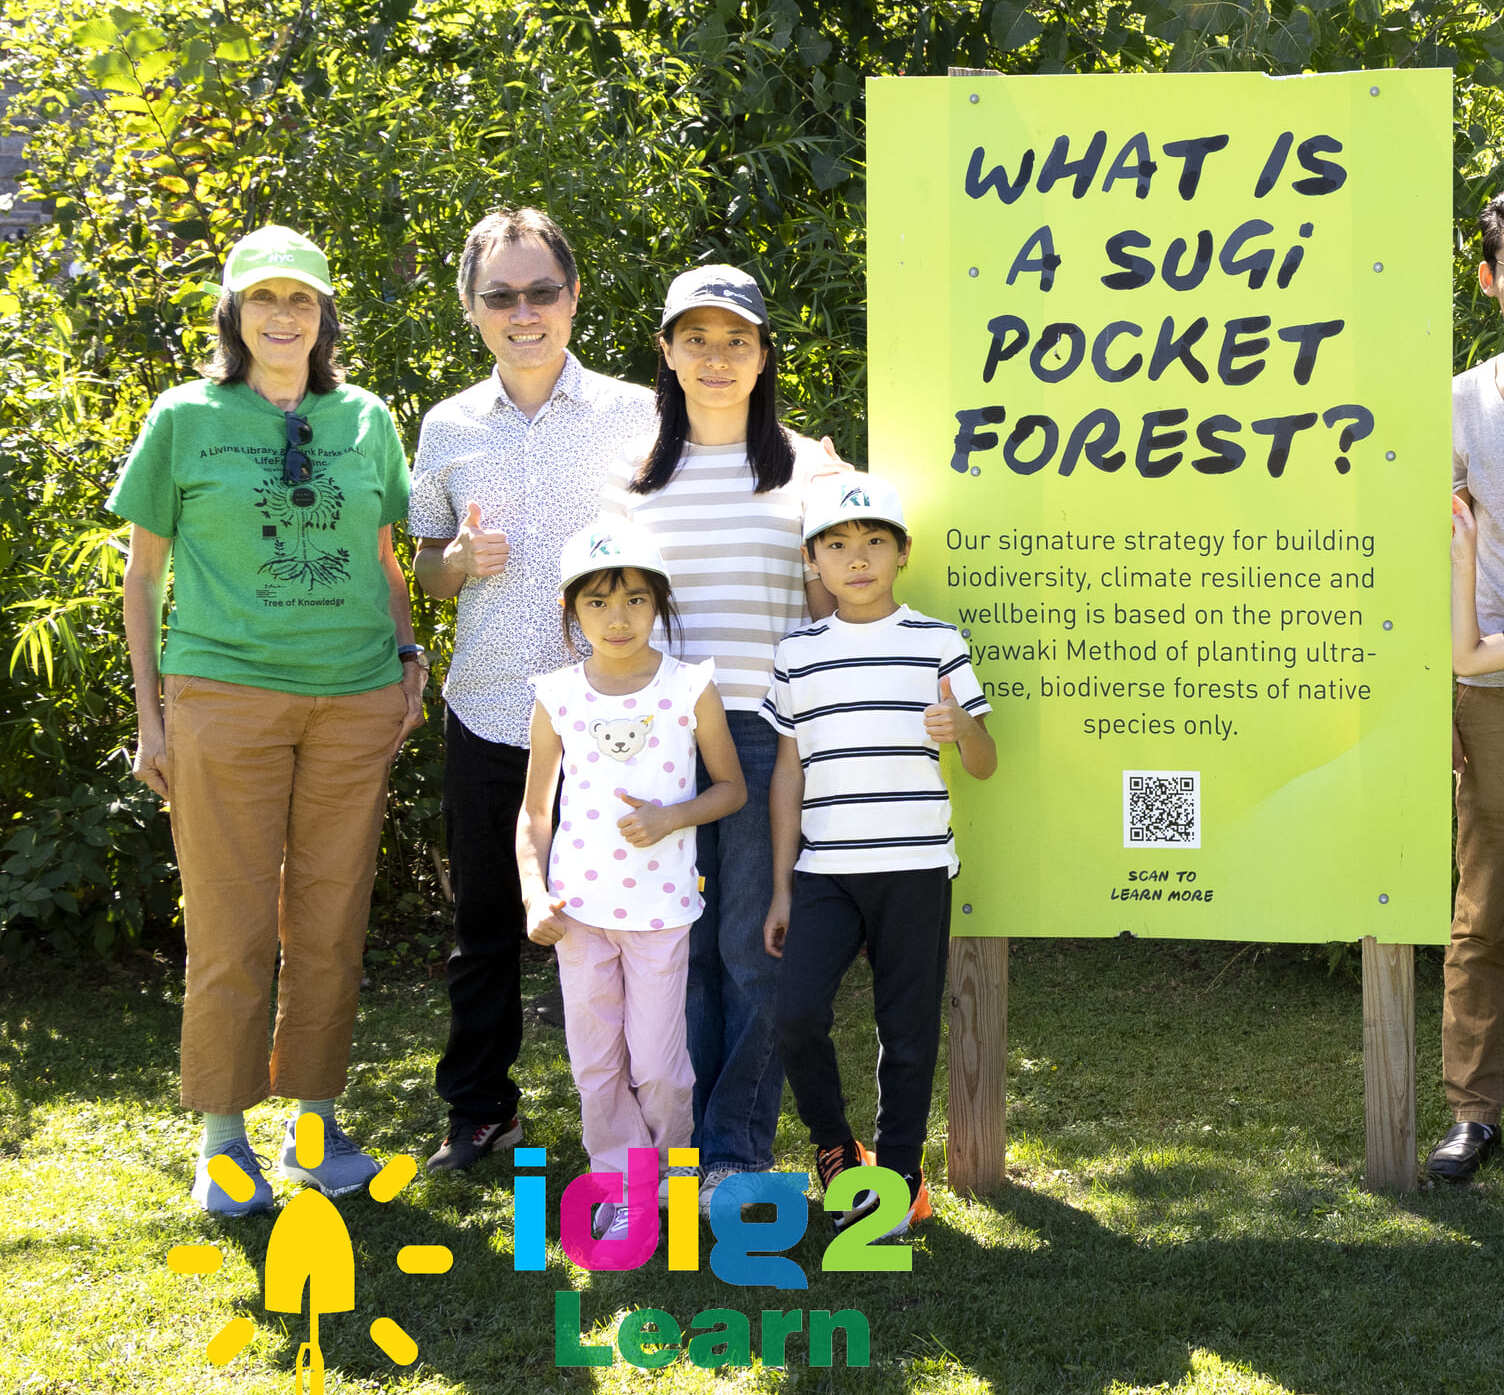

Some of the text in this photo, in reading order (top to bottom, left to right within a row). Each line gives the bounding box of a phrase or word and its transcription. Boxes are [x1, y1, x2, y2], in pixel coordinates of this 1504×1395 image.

[965, 130, 1348, 205] WHAT IS
[1005, 225, 1062, 292] A
[982, 314, 1345, 386] POCKET
[950, 404, 1375, 479] FOREST?
[946, 528, 1375, 557] Our signature strategy for building
[947, 565, 1375, 592] biodiversity, climate resilience and
[263, 597, 345, 608] Tree of Knowledge
[958, 602, 1362, 632] wellbeing is based on the proven
[968, 638, 1377, 668] iyawaki Method of planting ultra-
[982, 675, 1371, 700] nse, biodiverse forests of native
[1083, 714, 1238, 741] species only.
[1128, 870, 1197, 883] SCAN TO
[1110, 887, 1214, 903] LEARN MORE
